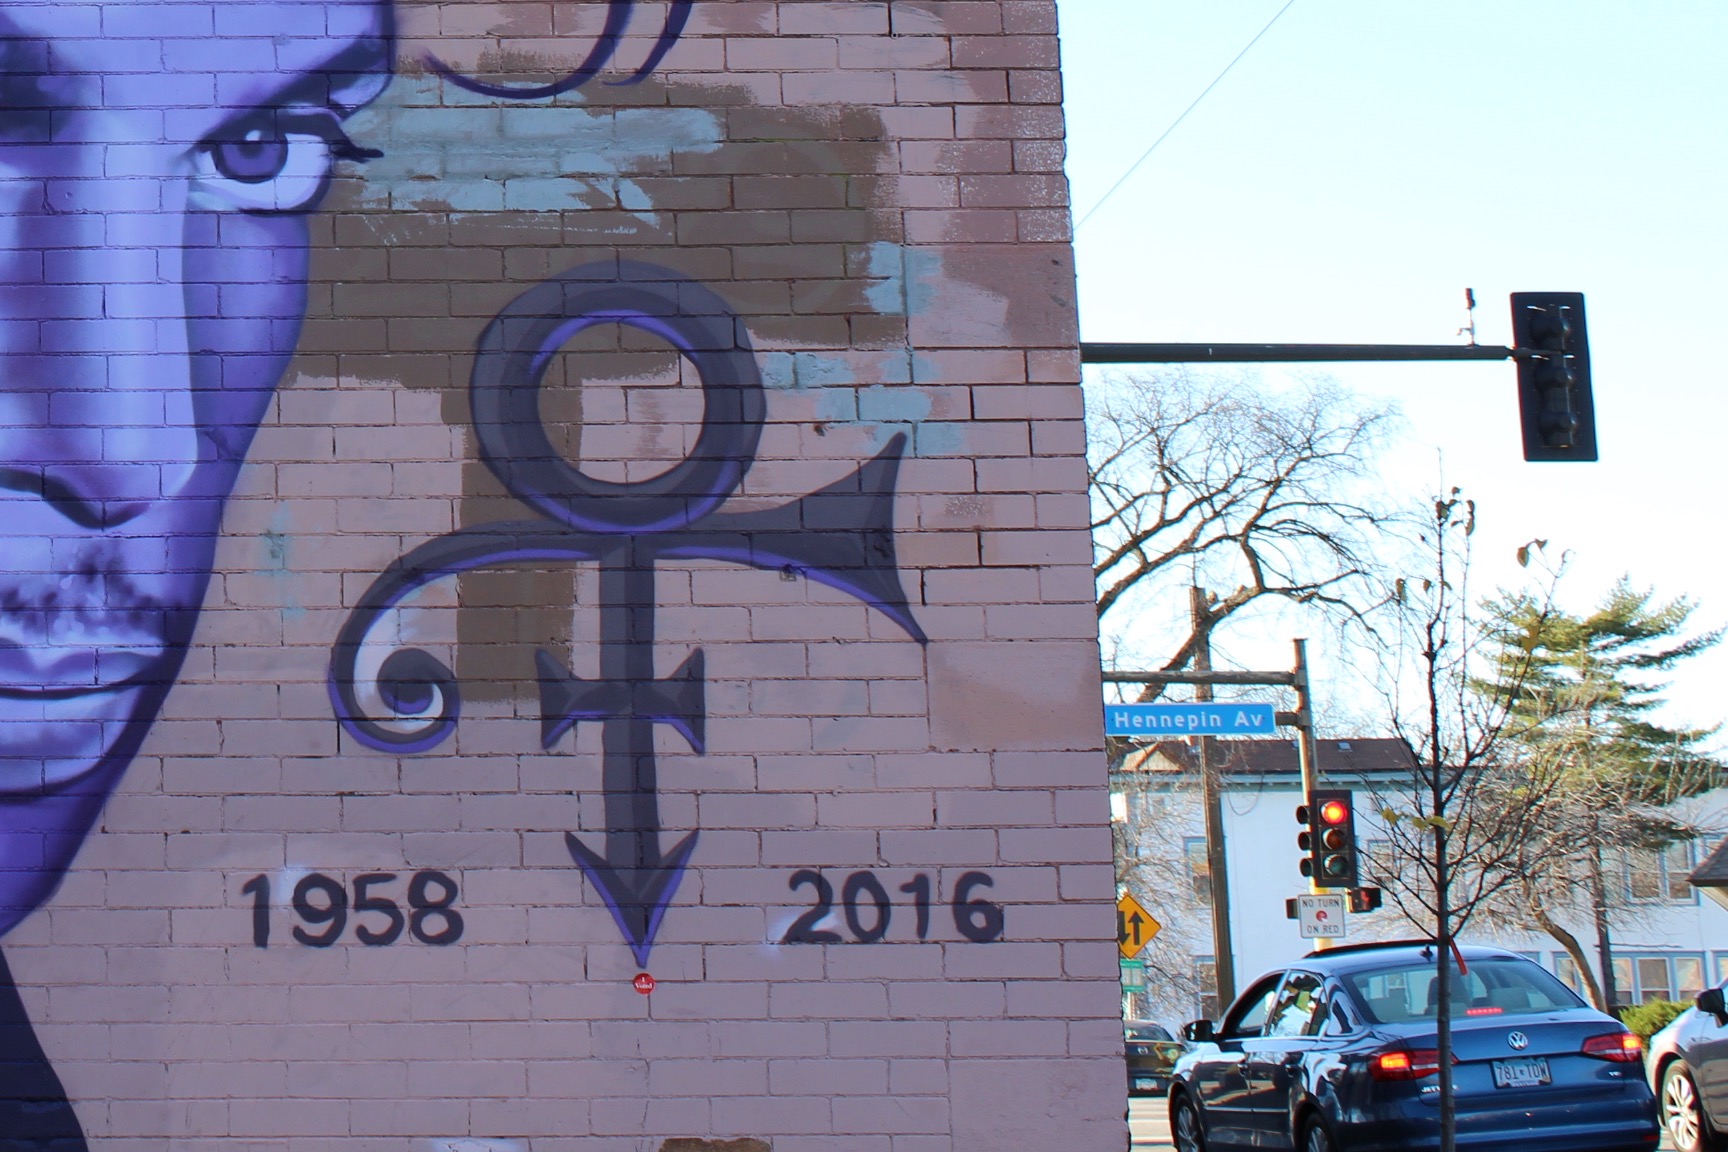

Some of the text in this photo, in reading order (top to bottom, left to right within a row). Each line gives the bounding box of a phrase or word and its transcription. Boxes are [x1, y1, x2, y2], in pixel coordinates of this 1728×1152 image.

[1114, 710, 1264, 731] Hennepin Av
[241, 869, 465, 949] 1958
[779, 868, 1004, 944] 2016
[1302, 898, 1340, 908] NO TURN
[1306, 924, 1340, 934] ON RED
[1496, 1065, 1519, 1081] 781
